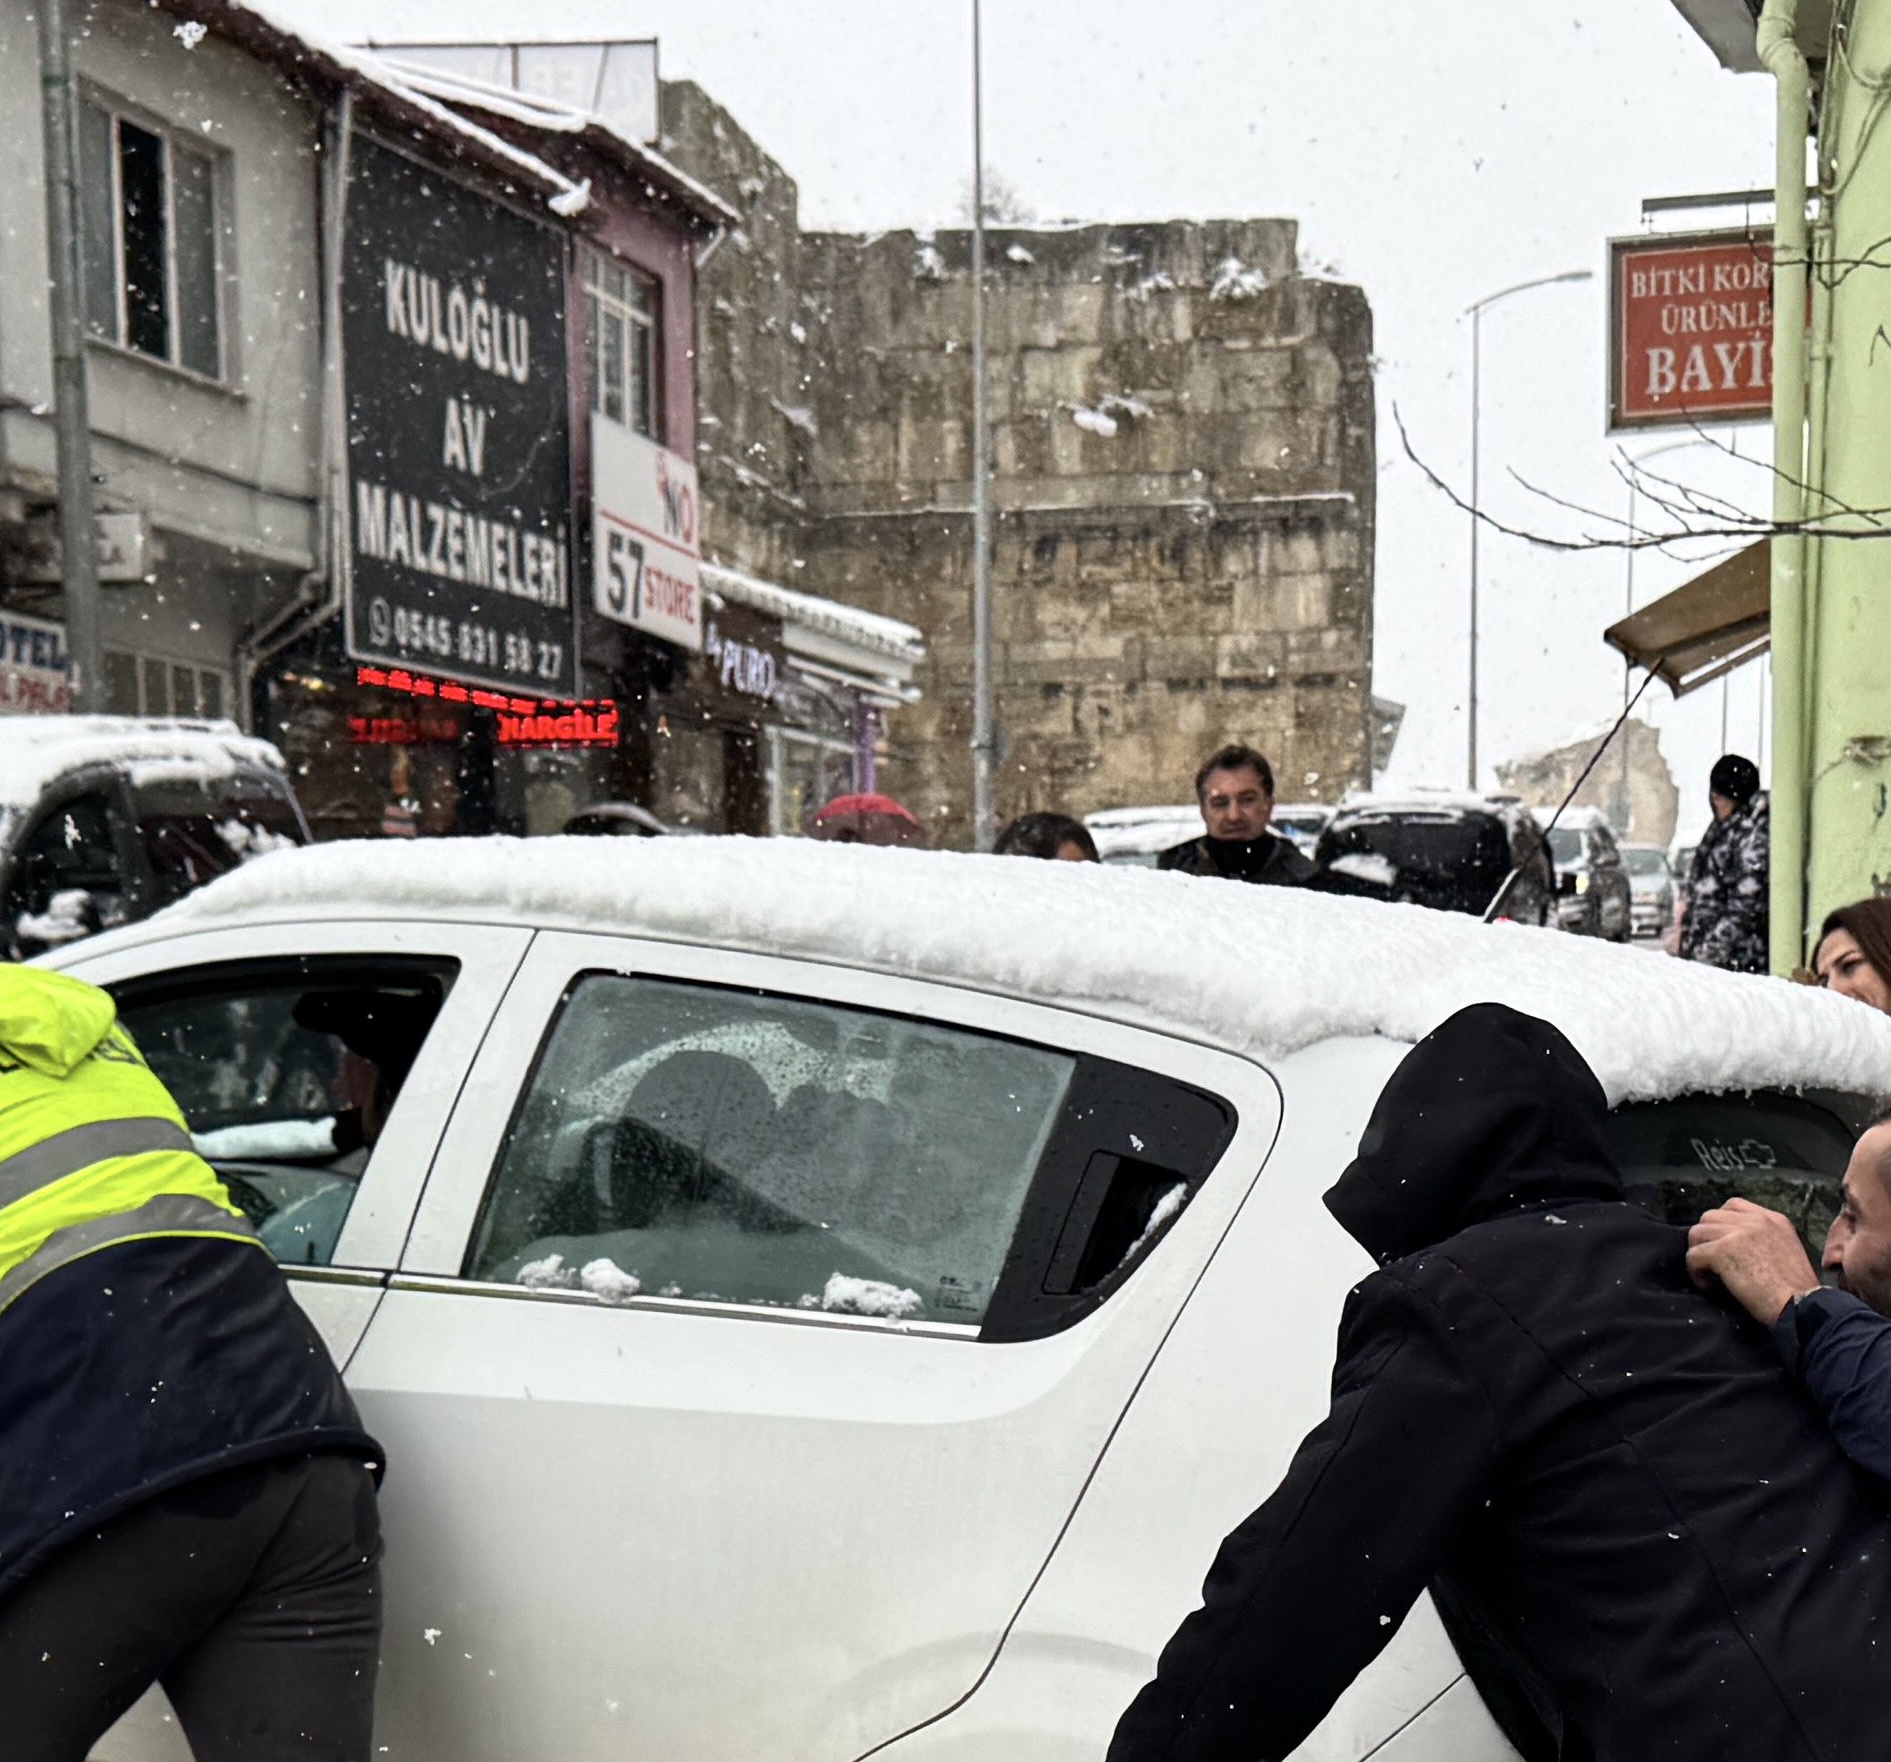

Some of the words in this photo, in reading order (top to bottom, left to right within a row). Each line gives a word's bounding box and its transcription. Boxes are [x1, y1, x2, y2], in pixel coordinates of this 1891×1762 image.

[1632, 262, 1705, 299] BİTKİ
[385, 258, 529, 386] KULOĞLU
[1645, 330, 1772, 396] BAYİ
[442, 398, 486, 477] AV
[357, 480, 568, 610] MALZEMELERİ
[607, 528, 644, 620] 57
[645, 564, 695, 626] STORE
[1690, 1137, 1745, 1171] Reis
